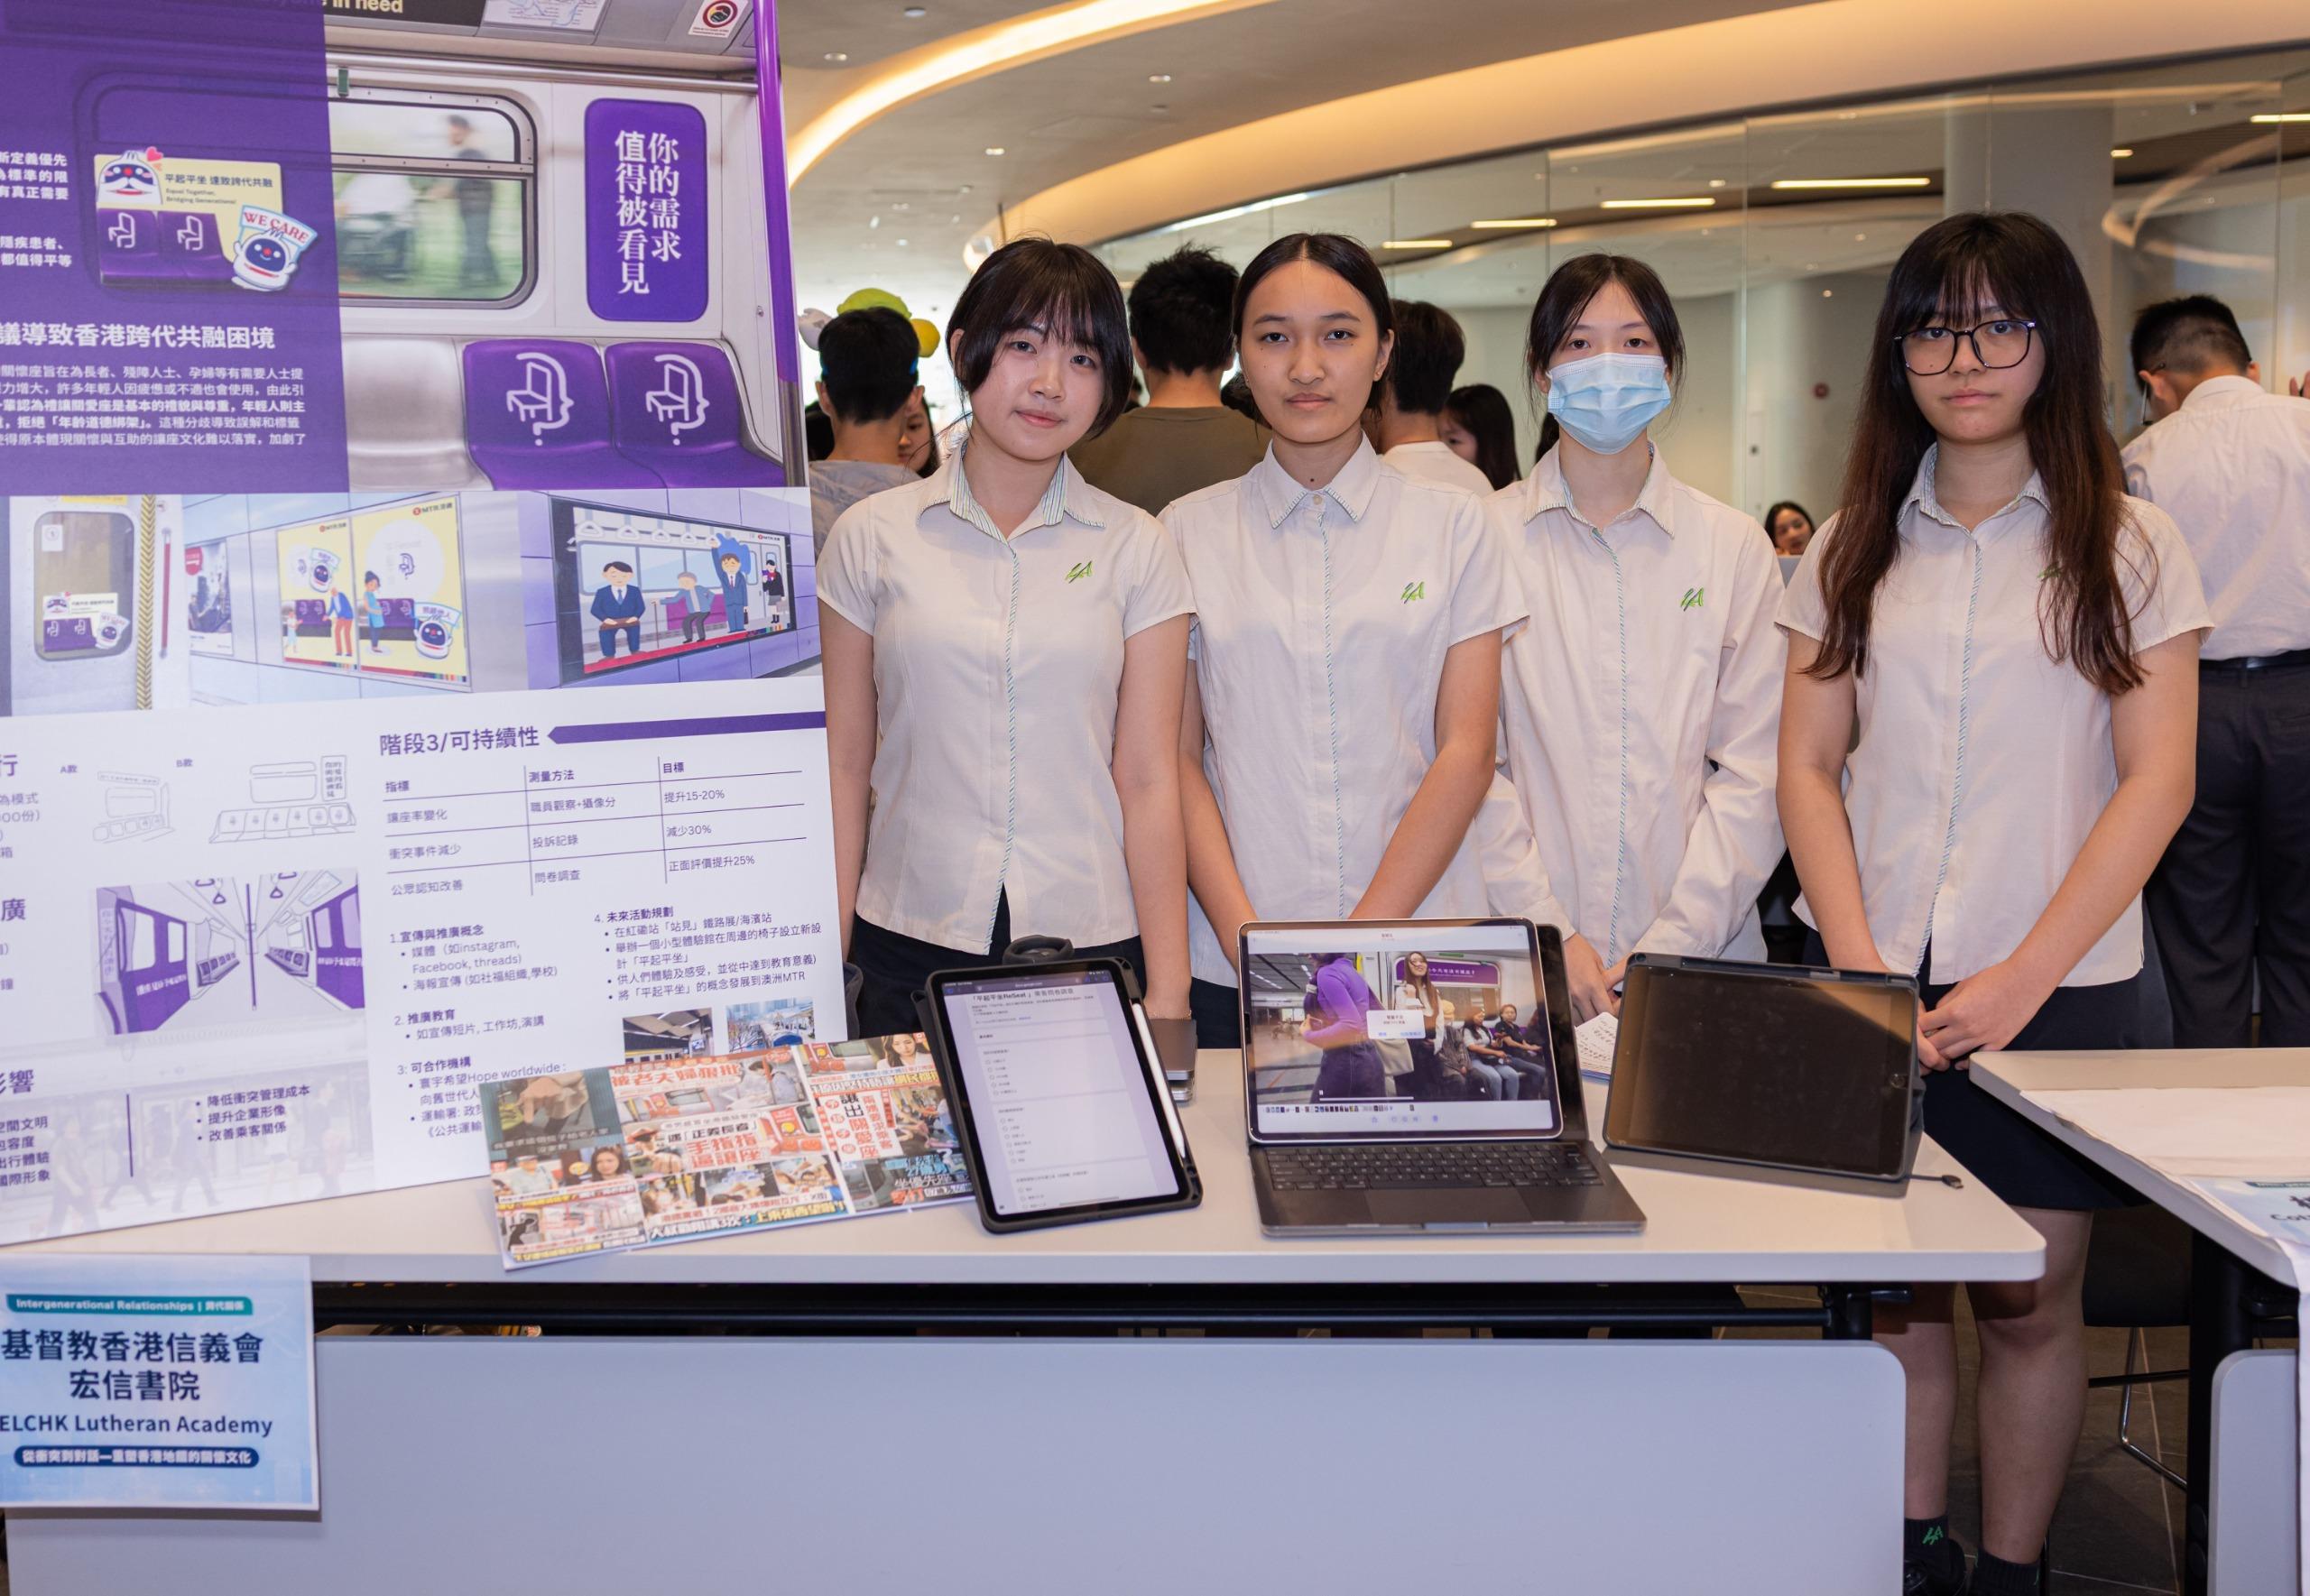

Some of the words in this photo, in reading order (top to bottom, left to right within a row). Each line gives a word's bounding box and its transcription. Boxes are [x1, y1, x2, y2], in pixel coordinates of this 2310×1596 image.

[648, 132, 682, 263] 你的需求
[614, 130, 650, 295] 值得被看見
[243, 211, 268, 227] WE
[269, 217, 311, 244] CARE
[0, 322, 276, 349] 議導致香港跨代共融困境
[380, 725, 540, 756] 階段3/可持續性
[529, 770, 575, 784] 測量方法
[663, 761, 685, 773] 目標
[385, 780, 410, 793] 指標
[664, 789, 725, 804] 提升15-20%
[666, 825, 712, 838] 減少30%
[669, 855, 755, 872] 正面評價提升25%
[1, 898, 26, 922] 廣
[207, 1084, 310, 1108] 降低衝突管理成本
[208, 1121, 287, 1142] 改善乘客關係
[16, 1299, 115, 1312] Intergenerational
[116, 1300, 194, 1313] Relationships
[1, 1328, 263, 1364] 基督教香港信義會
[69, 1370, 200, 1401] 宏信書院
[0, 1415, 69, 1433] ELCHK
[75, 1415, 171, 1434] Lutheran
[176, 1416, 273, 1438] Academy
